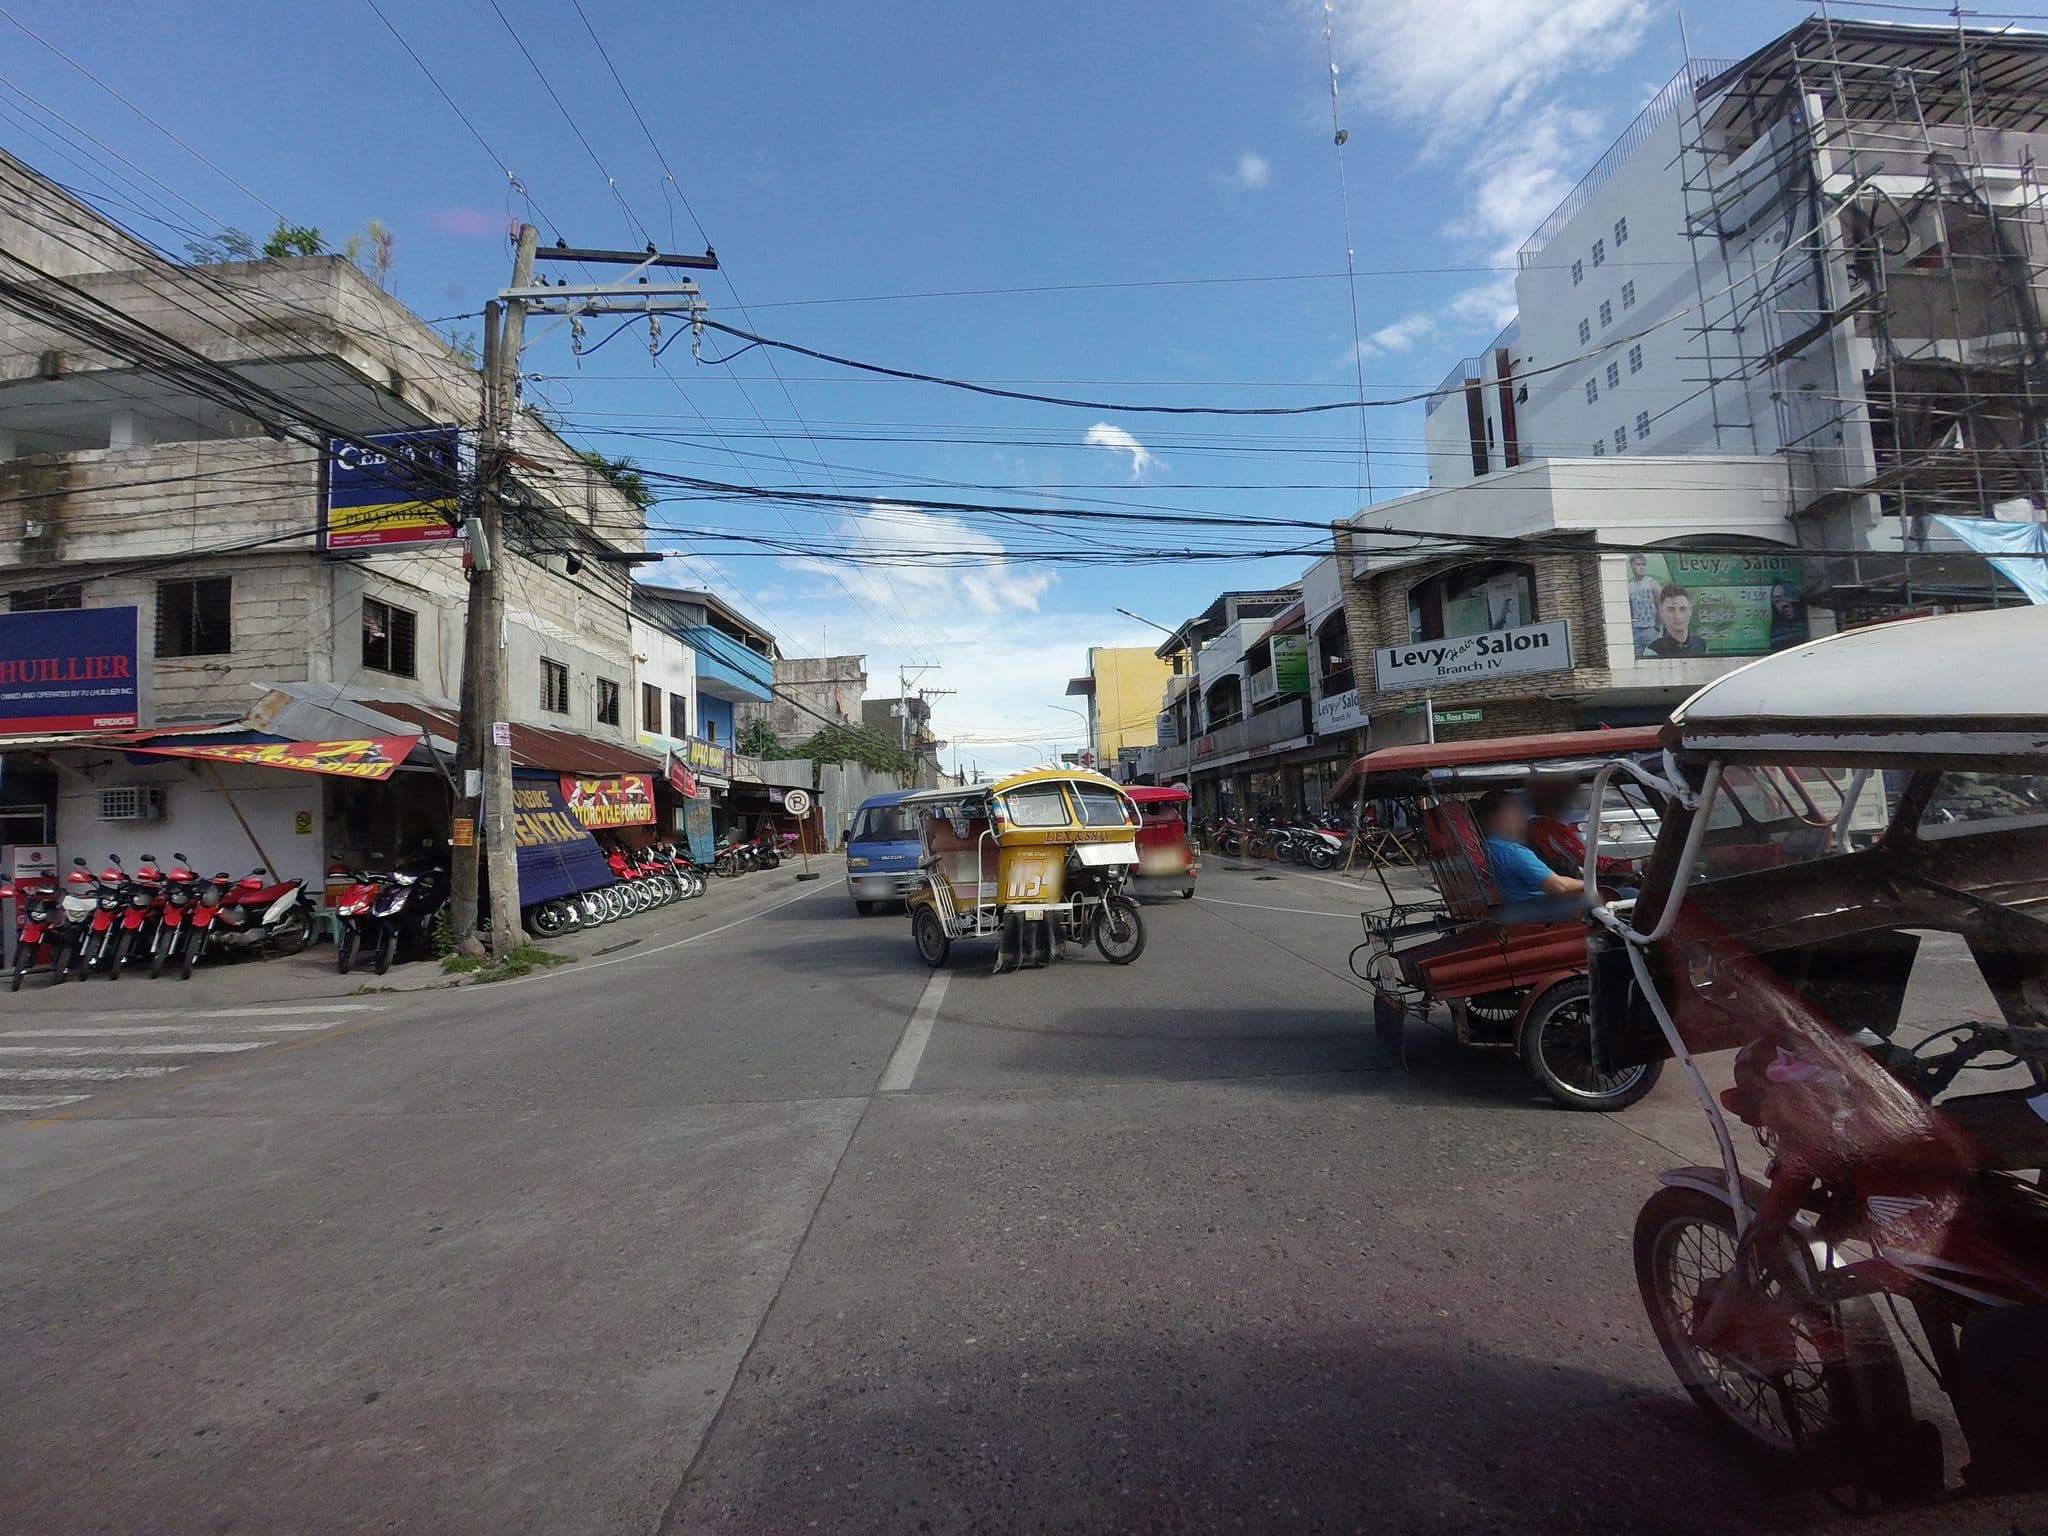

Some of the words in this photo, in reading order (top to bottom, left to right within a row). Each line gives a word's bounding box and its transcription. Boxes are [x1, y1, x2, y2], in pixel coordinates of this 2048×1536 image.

[1679, 553, 1721, 575] Levy
[1389, 647, 1447, 669] Levy
[1445, 638, 1476, 662] Hair
[1476, 631, 1550, 657] Salon
[0, 656, 129, 681] HUILLIER
[1437, 661, 1483, 676] Branch
[1487, 658, 1504, 670] IV
[1318, 702, 1334, 717] Levy
[1434, 714, 1446, 722] Sta.
[1447, 713, 1461, 722] Rosa
[1462, 711, 1480, 720] Street
